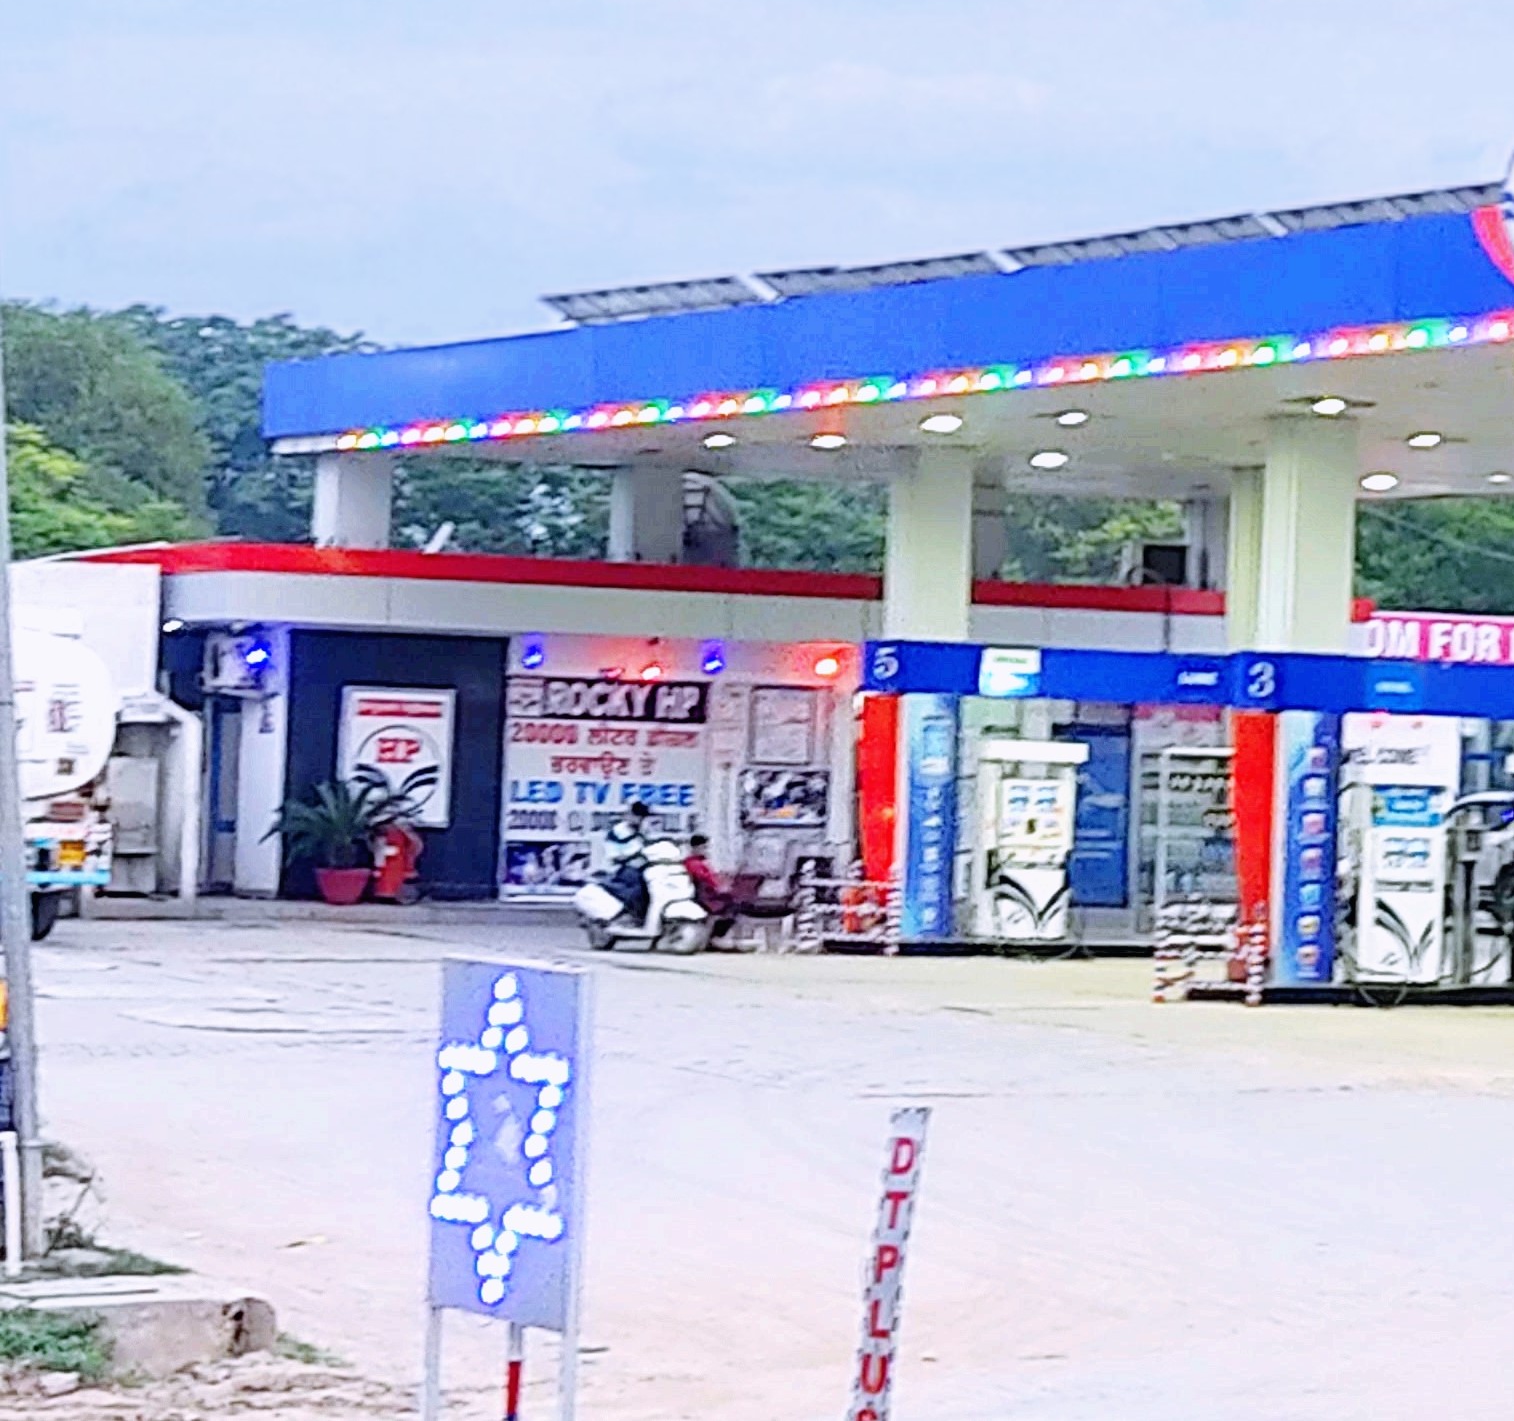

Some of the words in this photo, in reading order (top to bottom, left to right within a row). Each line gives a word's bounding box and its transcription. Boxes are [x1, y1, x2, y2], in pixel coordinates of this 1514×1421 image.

[1363, 619, 1419, 660] OM
[1429, 623, 1500, 665] FOR
[873, 647, 899, 680] 5
[1247, 662, 1276, 698] 3
[547, 682, 651, 717] ROCKY
[655, 686, 700, 719] HP
[377, 738, 421, 763] HP
[510, 781, 564, 803] LED
[574, 781, 611, 804] TV
[620, 782, 695, 807] FREE
